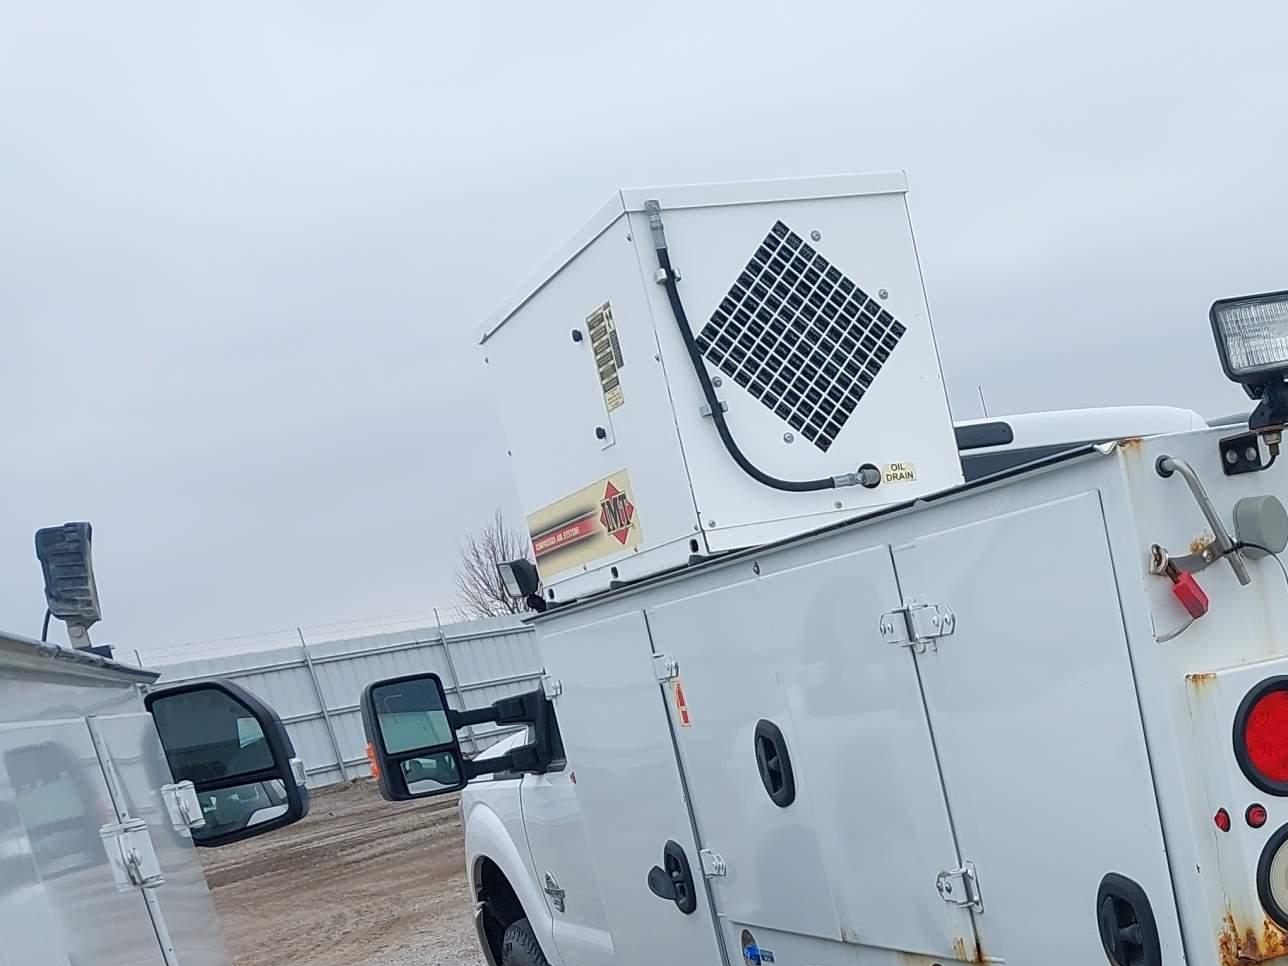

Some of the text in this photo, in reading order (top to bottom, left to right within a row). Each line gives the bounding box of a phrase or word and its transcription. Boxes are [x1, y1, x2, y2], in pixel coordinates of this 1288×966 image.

[890, 463, 906, 472] OIL
[886, 471, 914, 482] DRAIN
[600, 491, 632, 534] IMT
